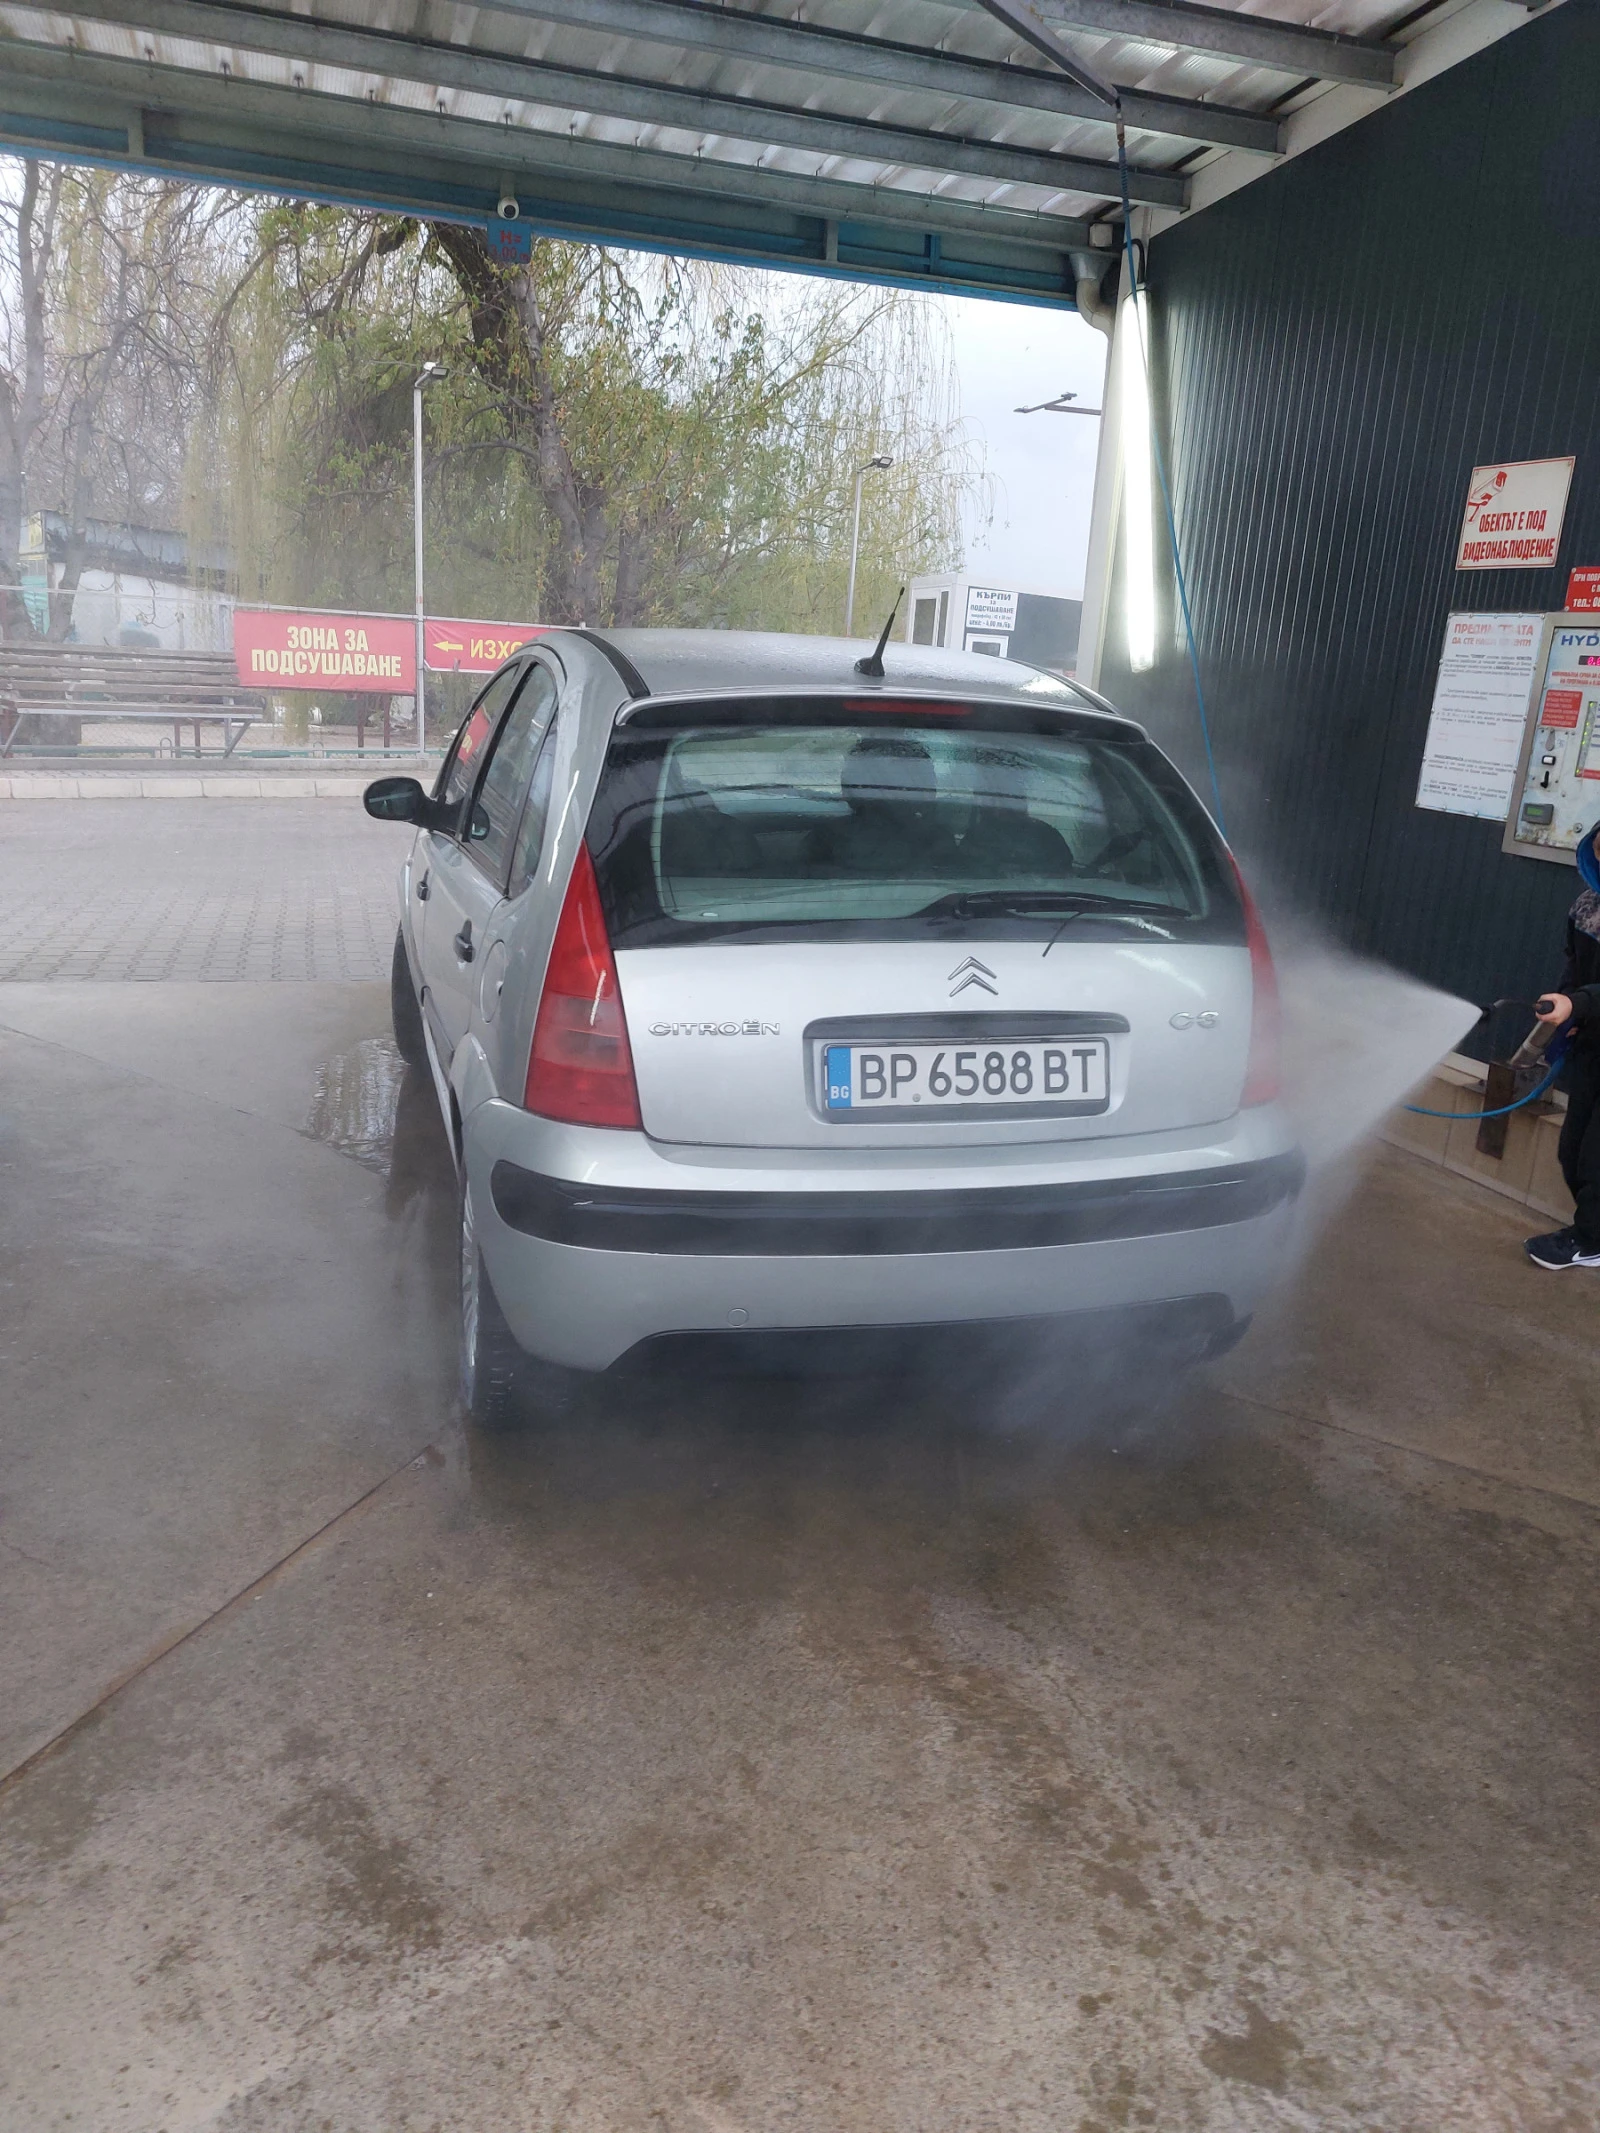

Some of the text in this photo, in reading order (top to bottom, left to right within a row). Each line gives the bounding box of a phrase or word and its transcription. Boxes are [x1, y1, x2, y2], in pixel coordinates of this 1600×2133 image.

[1479, 510, 1547, 532] ОБЕКТЪТ Е ПОД
[1462, 538, 1555, 562] ВИДЕОНАБЛЮДЕНИЕ
[976, 591, 1011, 601] КЪРПИ
[970, 604, 1015, 614] ПОДСУШАВАНЕ
[287, 626, 369, 651] ЗОНА ЗА
[251, 649, 402, 677] ПОДСУШАВАНЕ
[648, 1018, 780, 1036] CITROËN
[1168, 1010, 1219, 1031] C3
[860, 1049, 1097, 1099] BP 6588 BT
[830, 1085, 850, 1099] BG
